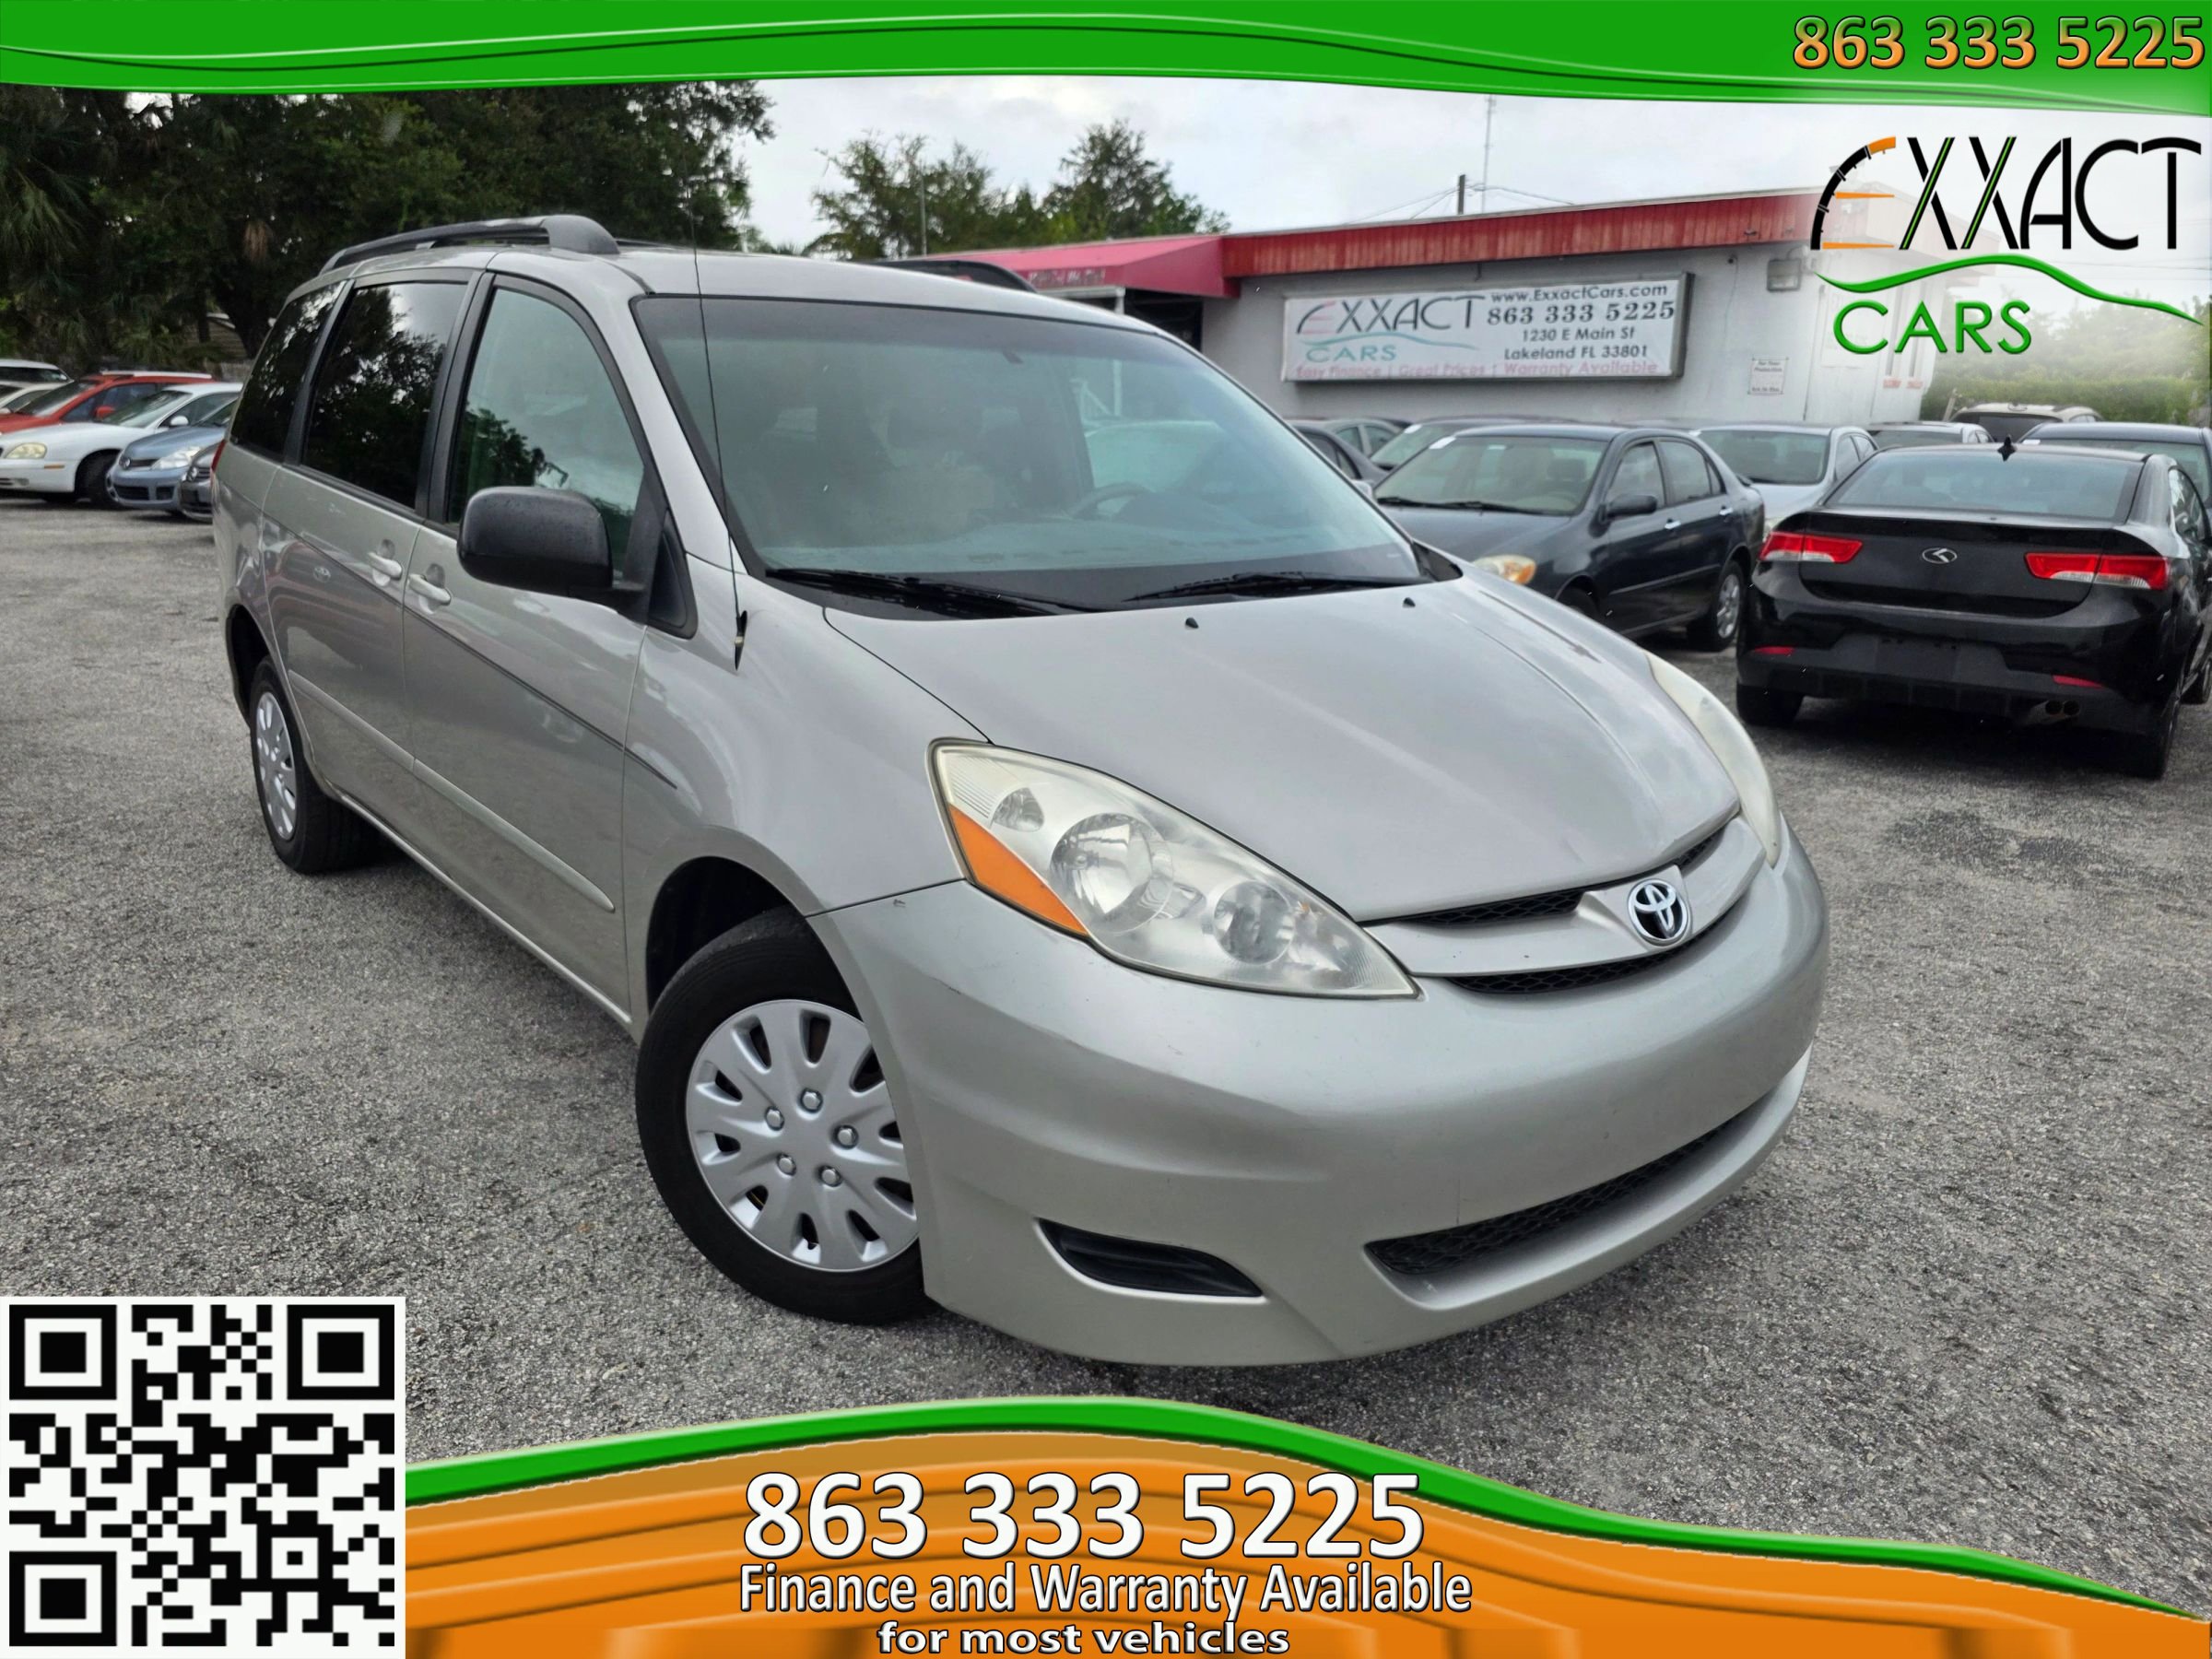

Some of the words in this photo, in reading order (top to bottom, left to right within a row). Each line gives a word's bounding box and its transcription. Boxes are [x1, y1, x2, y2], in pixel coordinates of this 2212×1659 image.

[1491, 285, 1668, 303] www.ExxactCars.com
[1295, 295, 1486, 335] EXXACT
[1488, 306, 1534, 325] 863
[1545, 304, 1594, 324] 333
[1606, 300, 1675, 322] 5225
[1522, 329, 1557, 342] 1230
[1561, 328, 1571, 341] E
[1575, 327, 1615, 341] Main
[1620, 325, 1635, 340] St
[1306, 345, 1397, 363] CARS
[1504, 347, 1575, 360] Lakeland
[1581, 347, 1595, 359] FL
[1602, 345, 1648, 359] 33801
[1504, 363, 1573, 376] Warranty
[1579, 360, 1658, 375] Available
